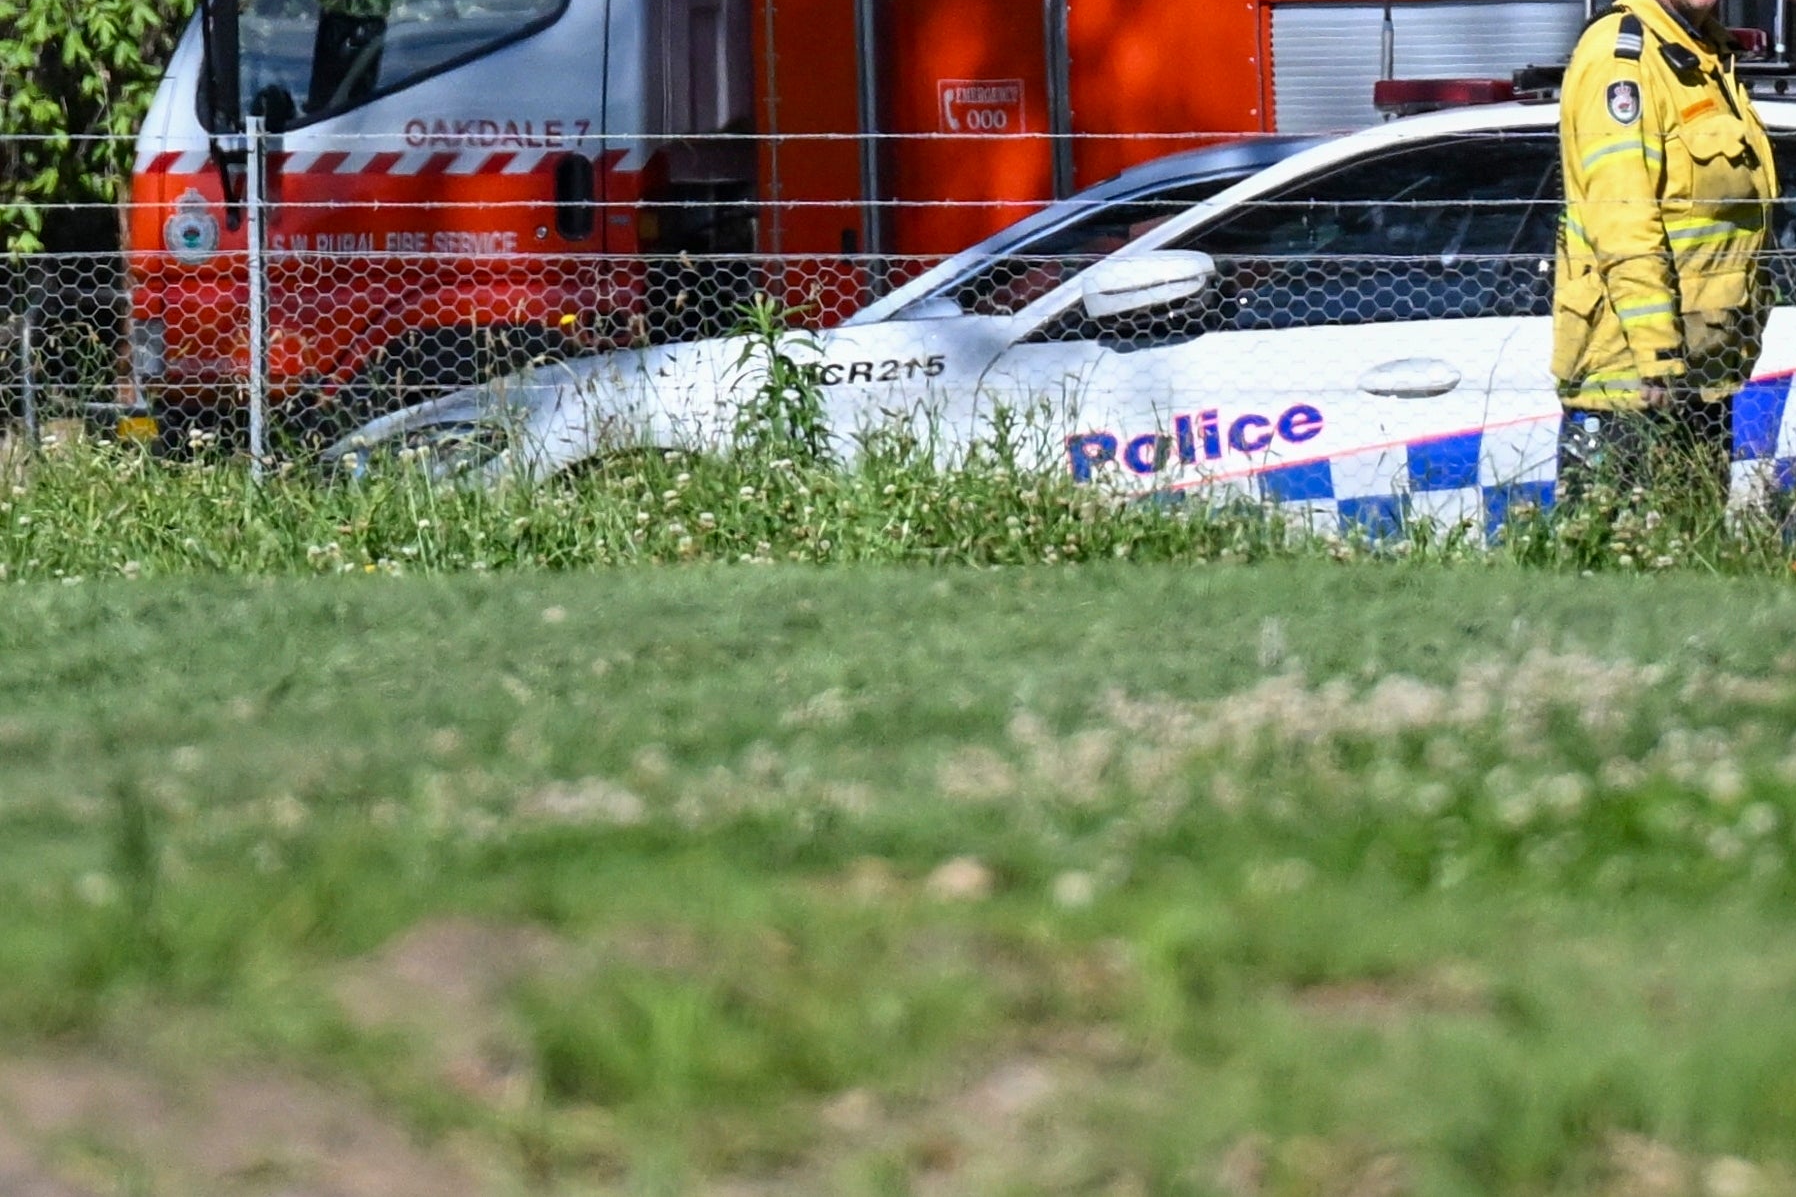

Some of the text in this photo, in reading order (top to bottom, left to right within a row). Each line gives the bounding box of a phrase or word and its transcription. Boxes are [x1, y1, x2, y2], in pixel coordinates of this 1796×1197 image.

[403, 117, 592, 148] OAKDALE 7
[966, 108, 1008, 131] 000
[1065, 402, 1324, 484] Police
